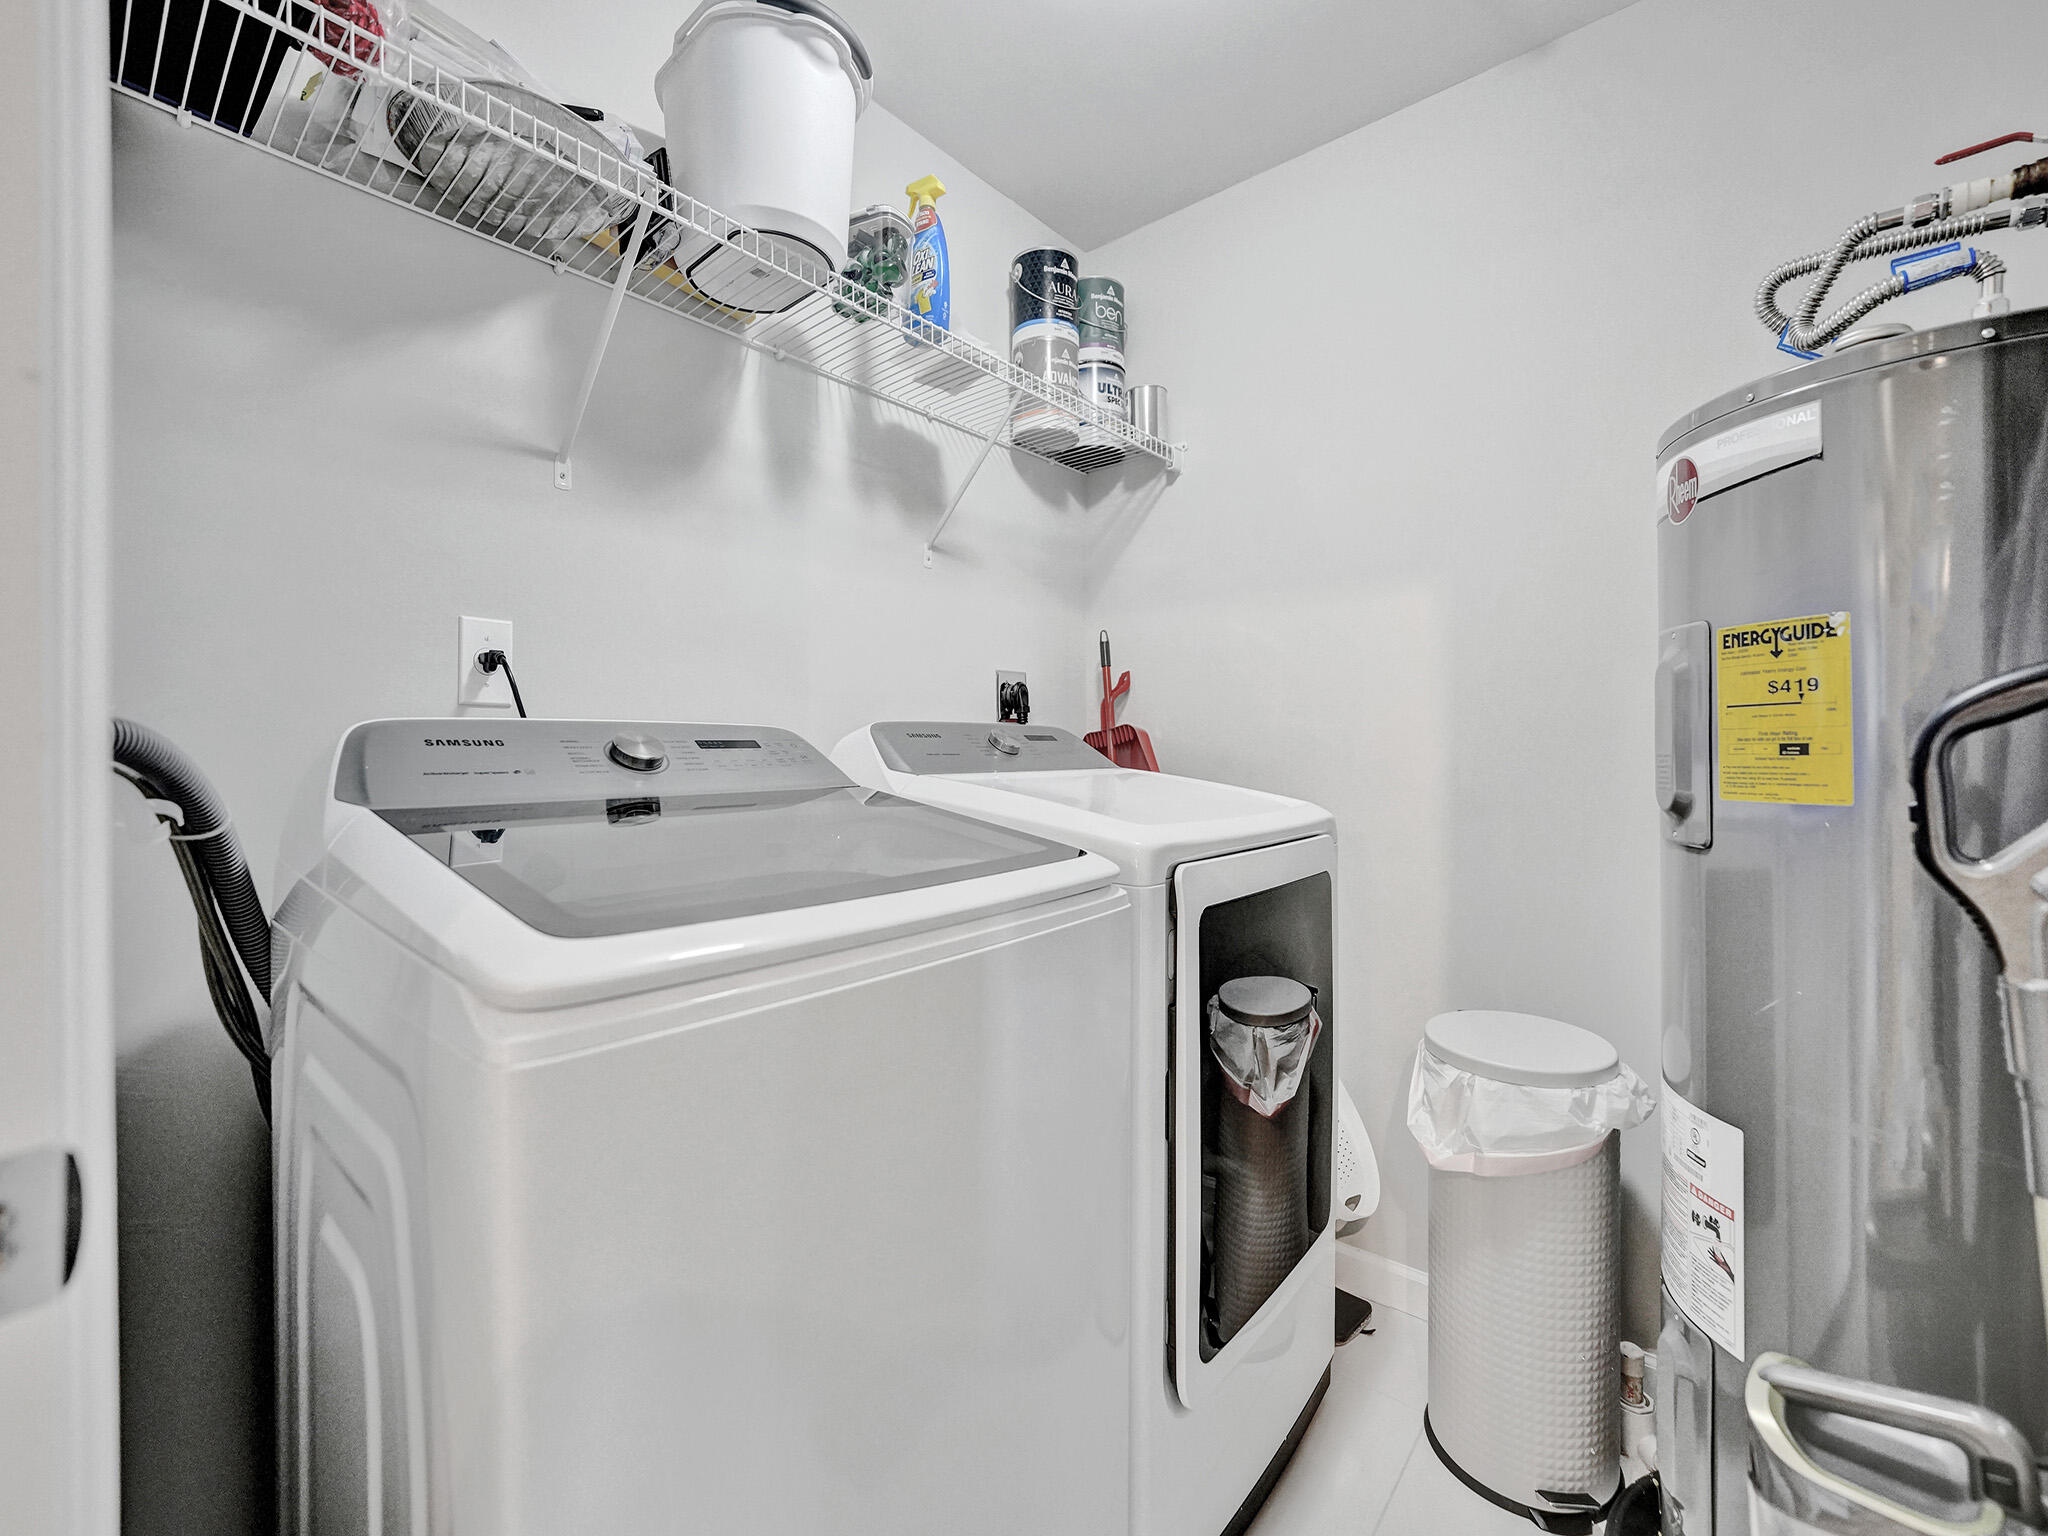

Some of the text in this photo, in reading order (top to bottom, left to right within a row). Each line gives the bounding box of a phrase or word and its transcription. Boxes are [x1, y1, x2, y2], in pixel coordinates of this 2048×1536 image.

[1048, 281, 1077, 302] AURA
[1095, 301, 1123, 327] ben
[1668, 464, 1697, 515] Rheem
[1722, 622, 1837, 654] ENERGYGUIDE
[1768, 677, 1819, 695] $419
[423, 738, 505, 747] SAMSUNG
